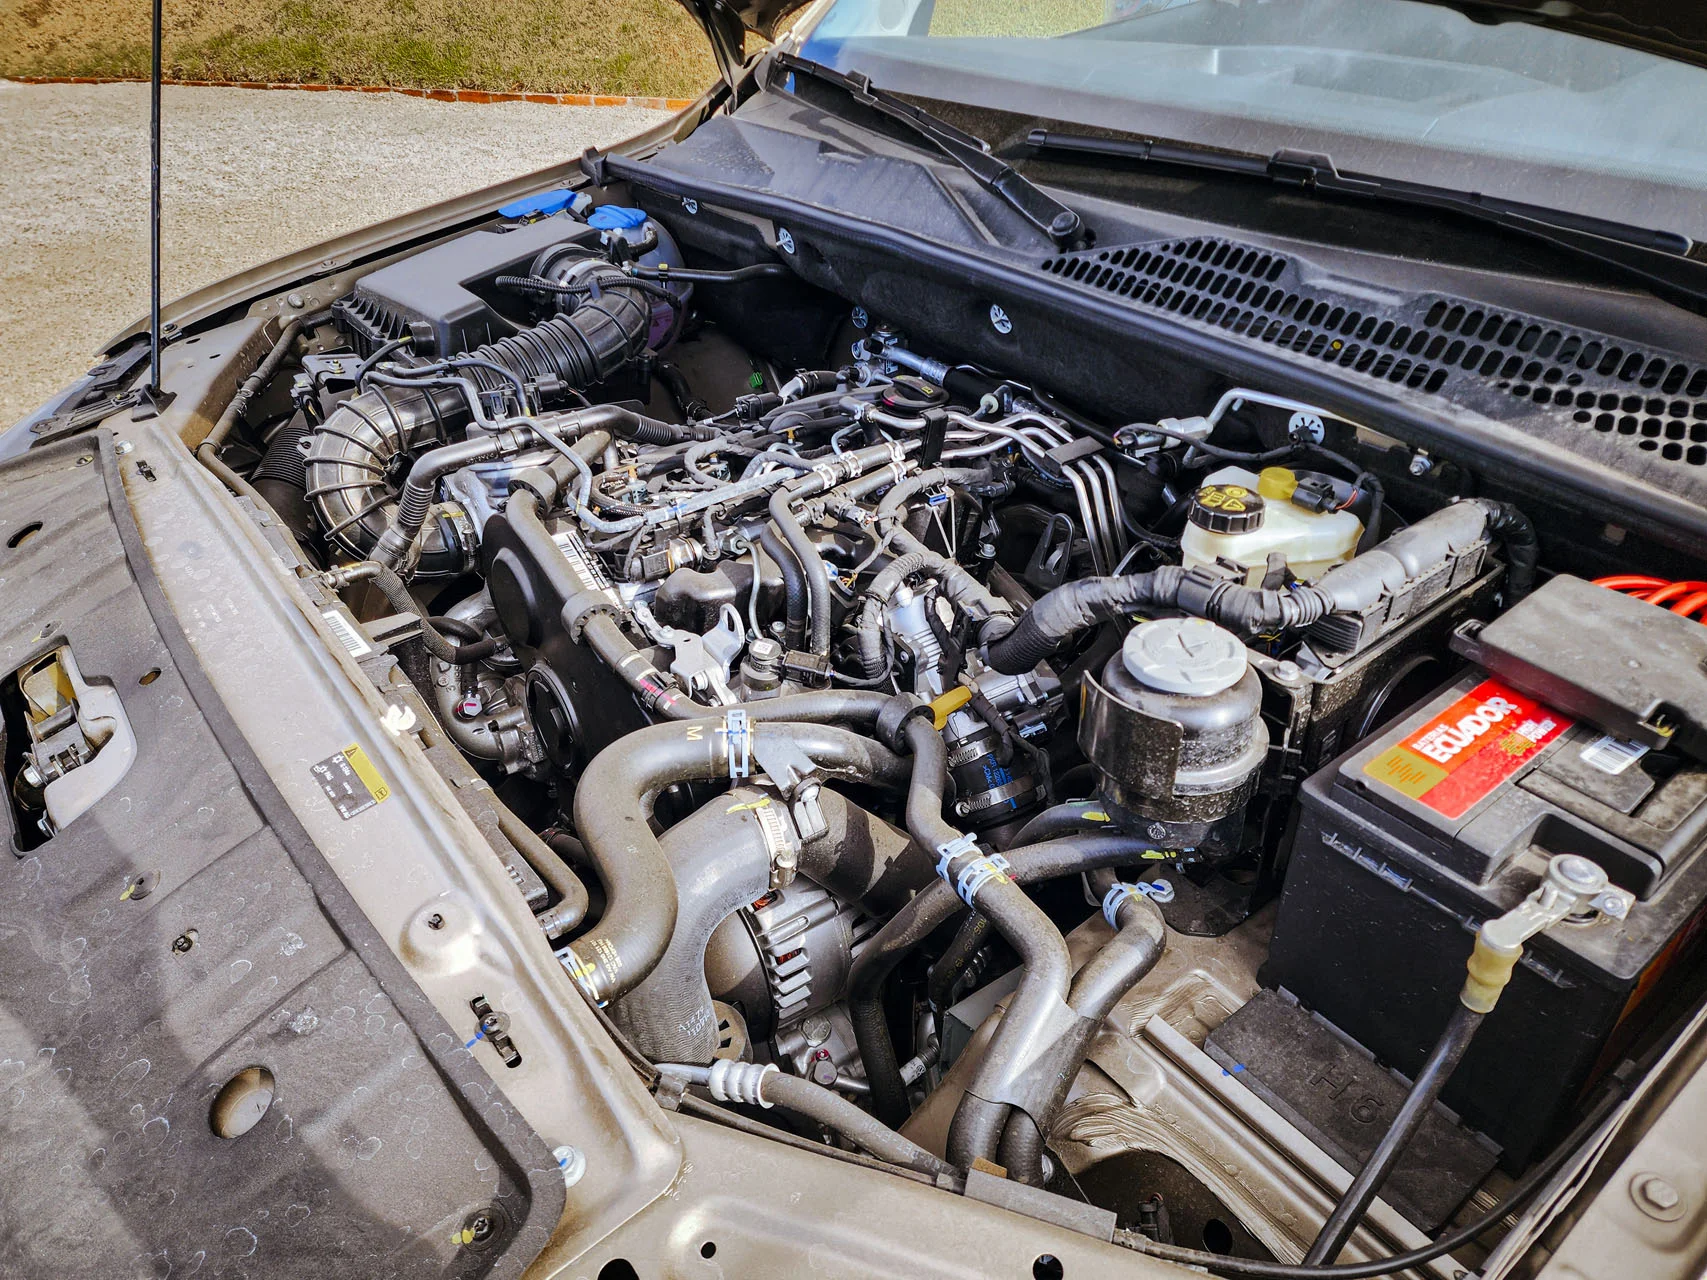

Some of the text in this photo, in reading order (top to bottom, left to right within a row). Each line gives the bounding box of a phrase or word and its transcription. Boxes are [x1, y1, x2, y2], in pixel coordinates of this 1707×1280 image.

[686, 725, 704, 741] M
[1421, 696, 1518, 763] ECUADOR
[1309, 1063, 1385, 1124] H6
